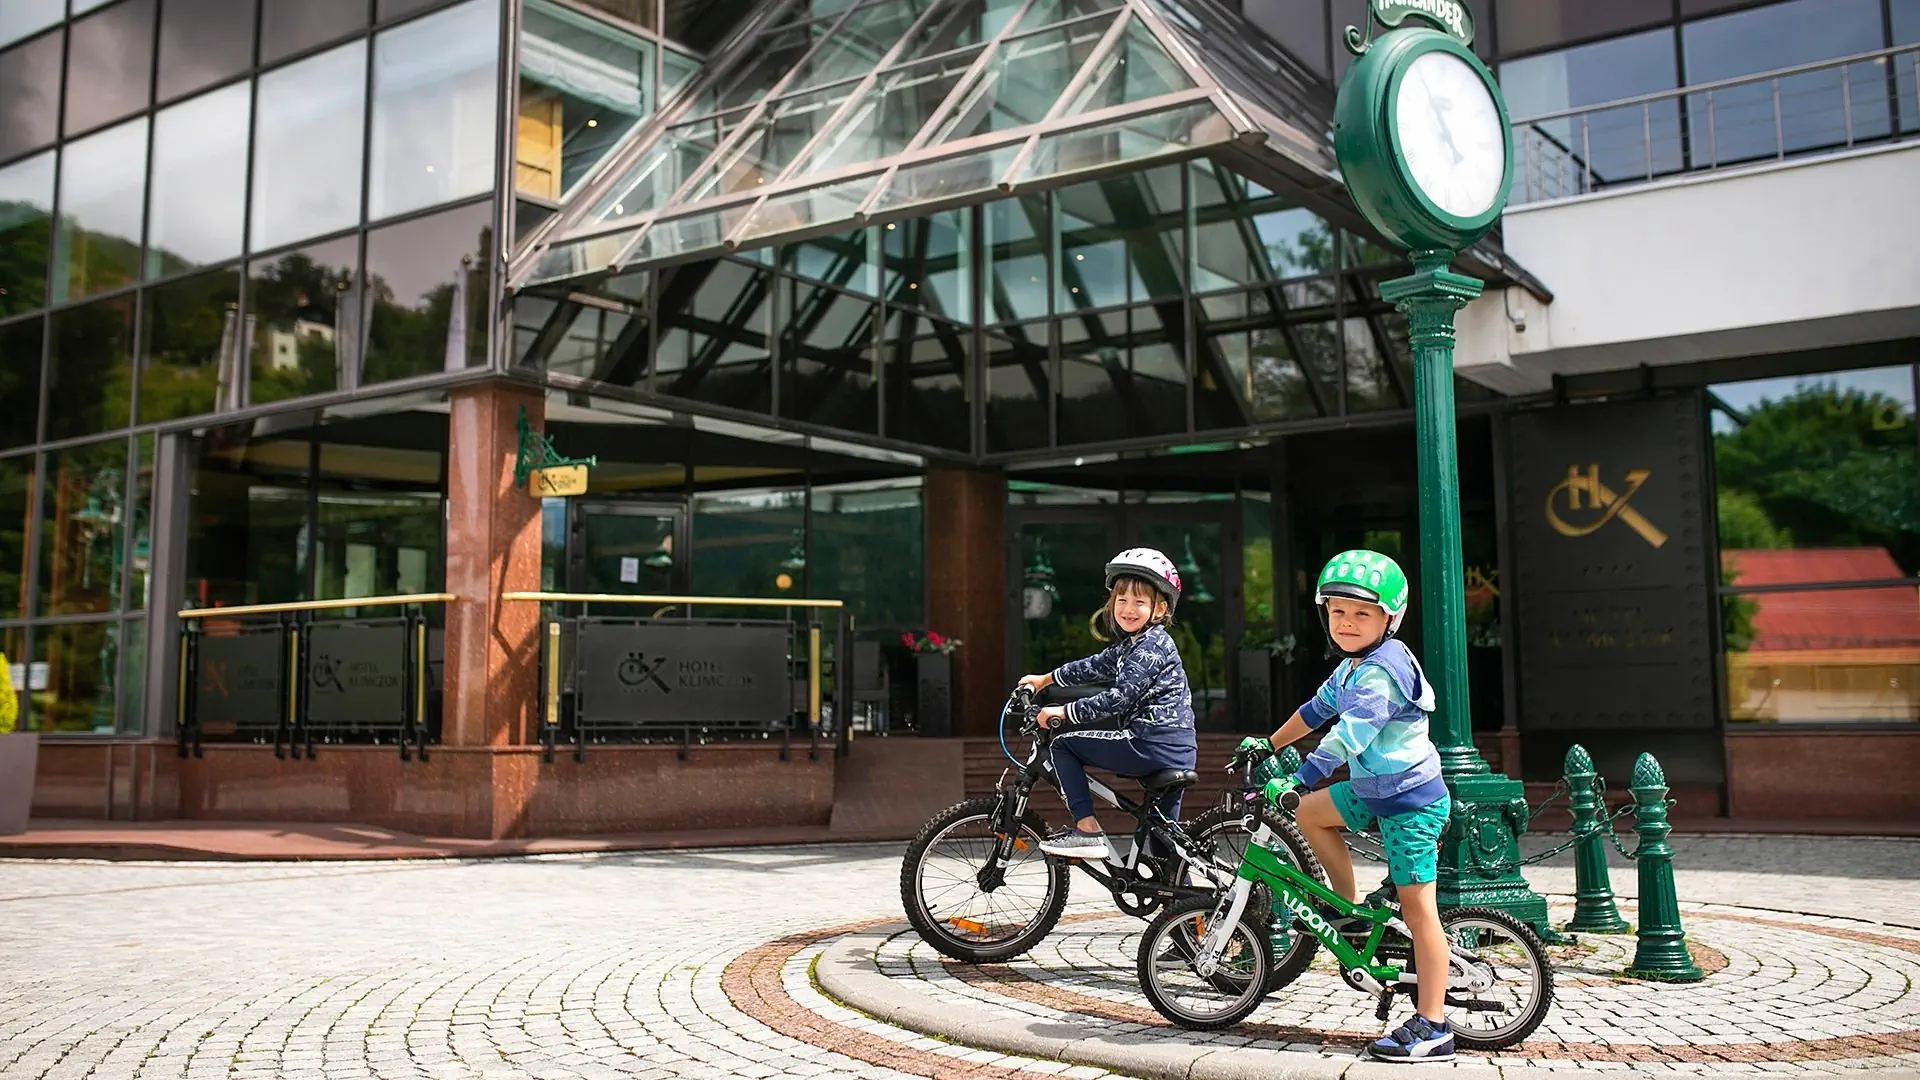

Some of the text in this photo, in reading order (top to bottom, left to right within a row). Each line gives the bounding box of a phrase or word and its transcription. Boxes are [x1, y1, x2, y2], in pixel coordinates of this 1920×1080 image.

[678, 660, 724, 673] HOTEL
[678, 674, 754, 688] KLIMCOK
[1283, 890, 1339, 945] woom
[1212, 950, 1221, 960] 14
